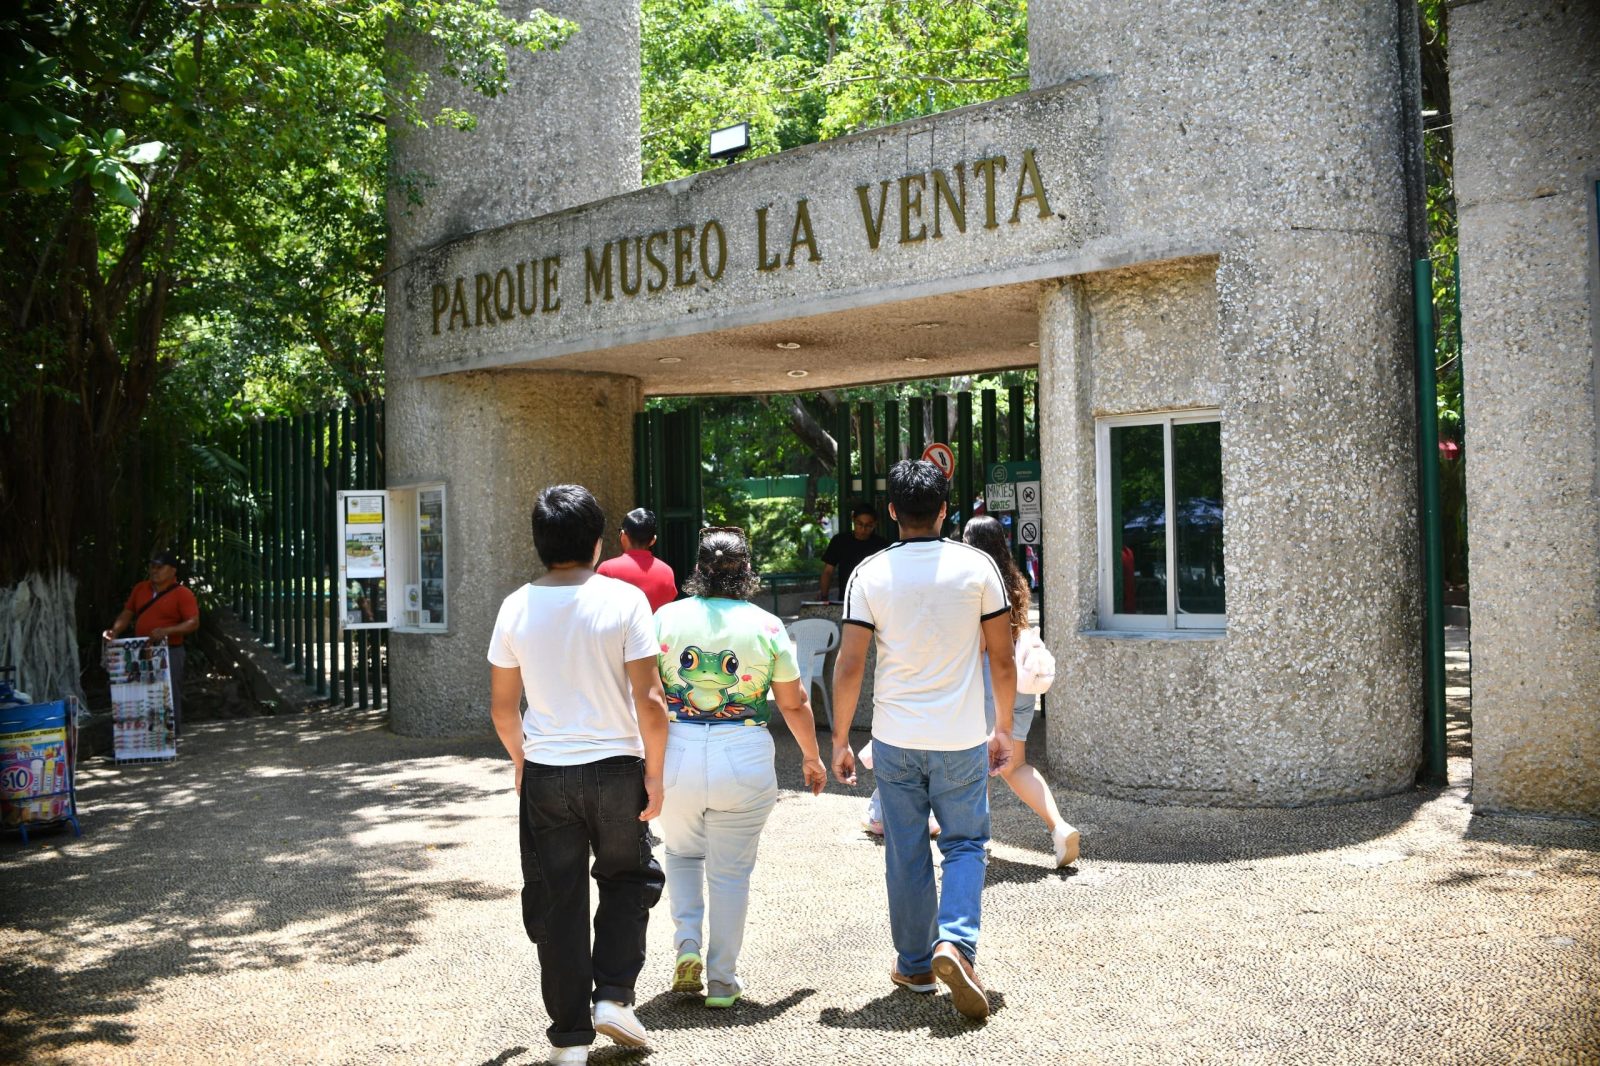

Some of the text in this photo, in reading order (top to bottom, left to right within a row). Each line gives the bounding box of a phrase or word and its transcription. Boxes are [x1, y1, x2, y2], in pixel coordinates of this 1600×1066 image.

[431, 149, 1054, 336] PARQUE MUSEO LA VENTA
[987, 483, 1014, 498] MARTES
[990, 500, 1010, 510] GRATIS
[2, 769, 28, 789] $10
